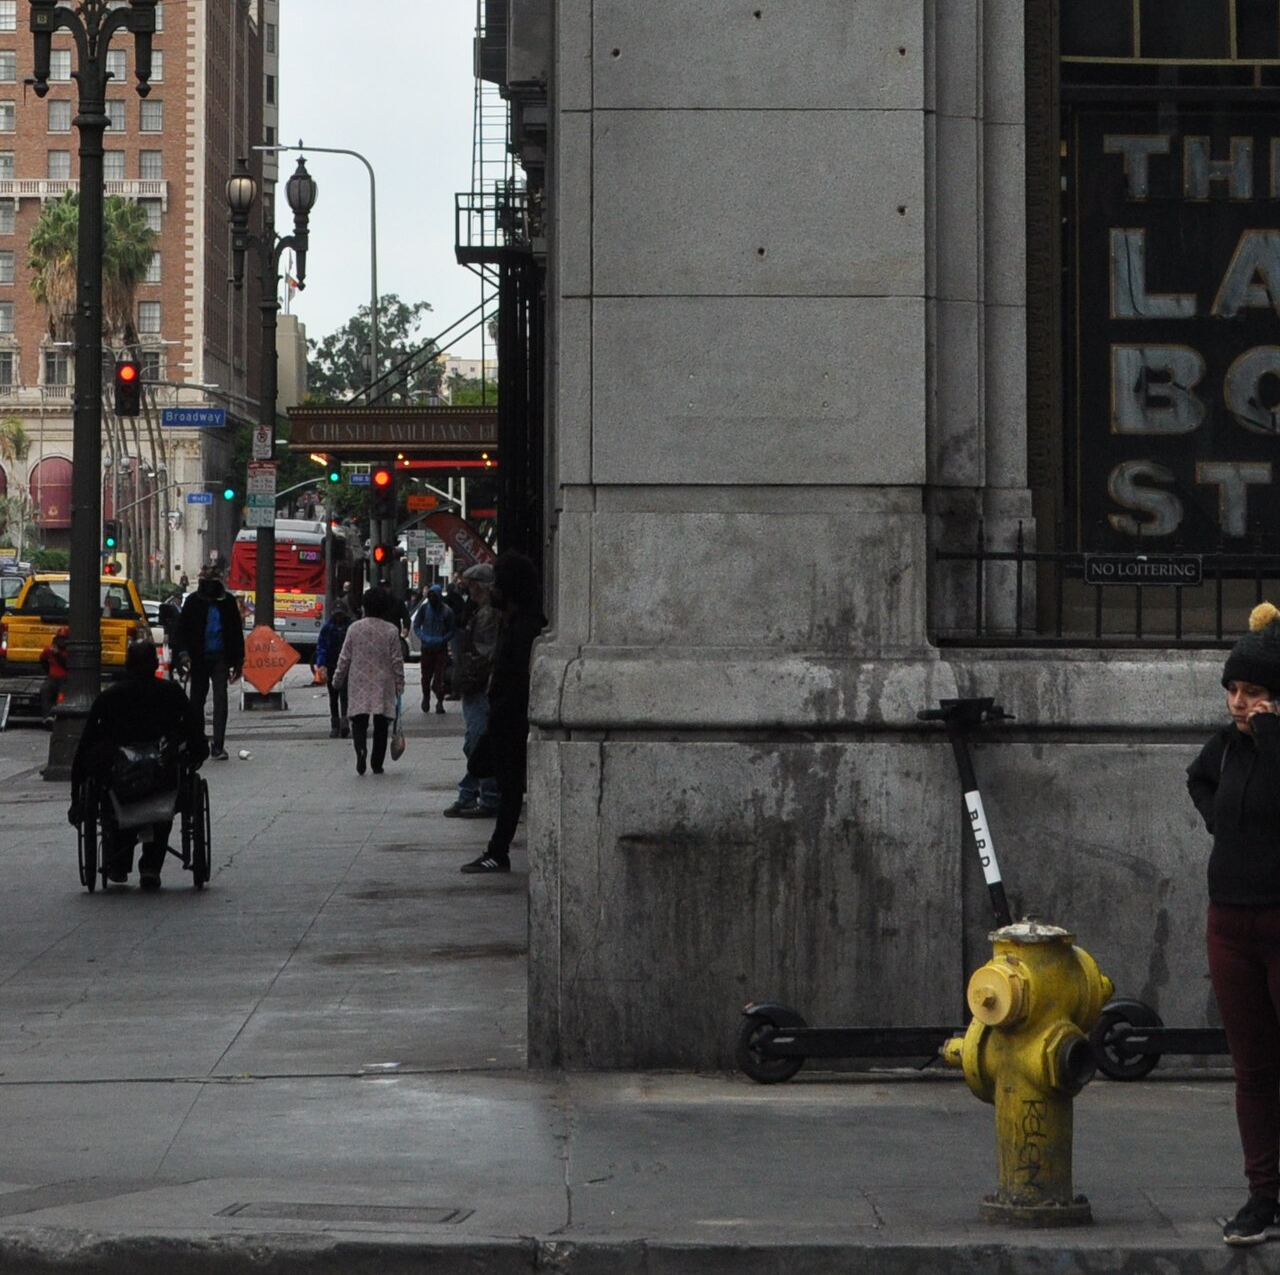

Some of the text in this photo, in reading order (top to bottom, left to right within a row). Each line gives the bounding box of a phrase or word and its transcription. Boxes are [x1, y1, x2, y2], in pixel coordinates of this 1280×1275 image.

[165, 411, 222, 424] Broadway
[389, 424, 471, 441] WILLIAMS
[1091, 563, 1196, 576] NO LOITERING
[969, 808, 991, 868] BIRD
